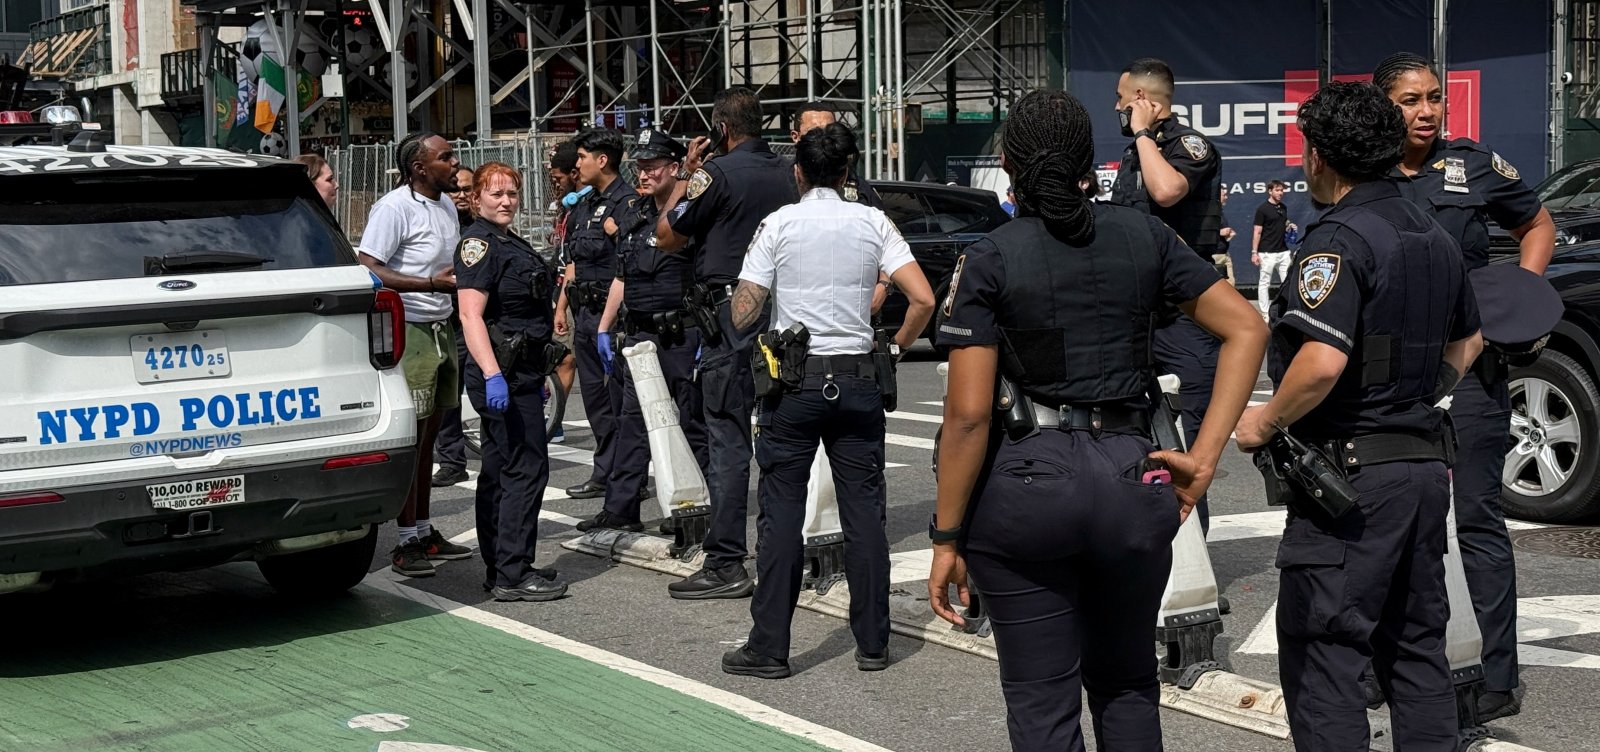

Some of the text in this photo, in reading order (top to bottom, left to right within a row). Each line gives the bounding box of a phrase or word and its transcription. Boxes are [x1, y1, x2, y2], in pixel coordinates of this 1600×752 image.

[145, 344, 226, 370] 4270 25
[37, 387, 321, 445] NYPD POLICE
[129, 433, 242, 456] @NYPDNEWS
[148, 483, 193, 498] $10,000
[196, 478, 241, 492] REWARD
[168, 499, 187, 508] 1-800
